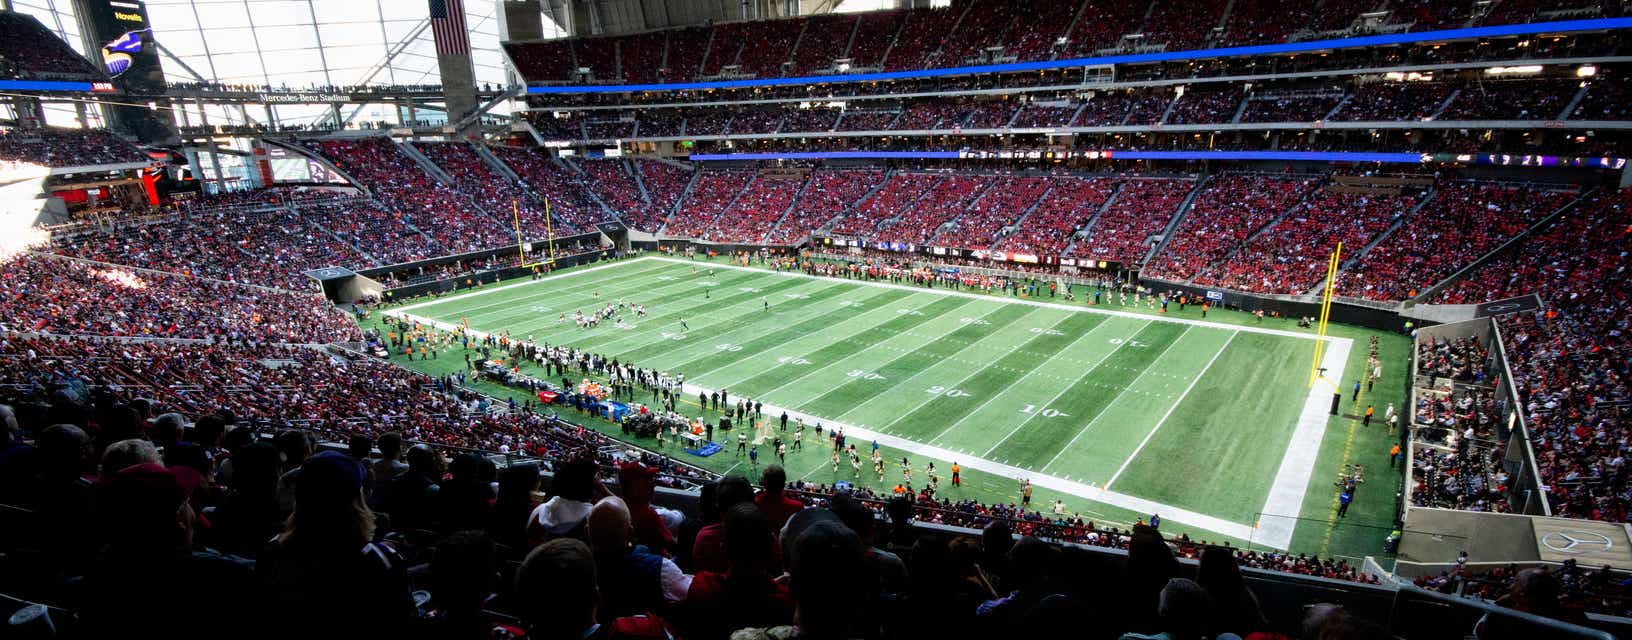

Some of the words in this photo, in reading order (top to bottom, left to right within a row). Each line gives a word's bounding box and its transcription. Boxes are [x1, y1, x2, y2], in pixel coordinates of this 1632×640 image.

[260, 94, 318, 102] Mercedes-Benz
[319, 94, 351, 102] Stadium
[926, 385, 963, 398] 20
[1018, 404, 1063, 418] 10
